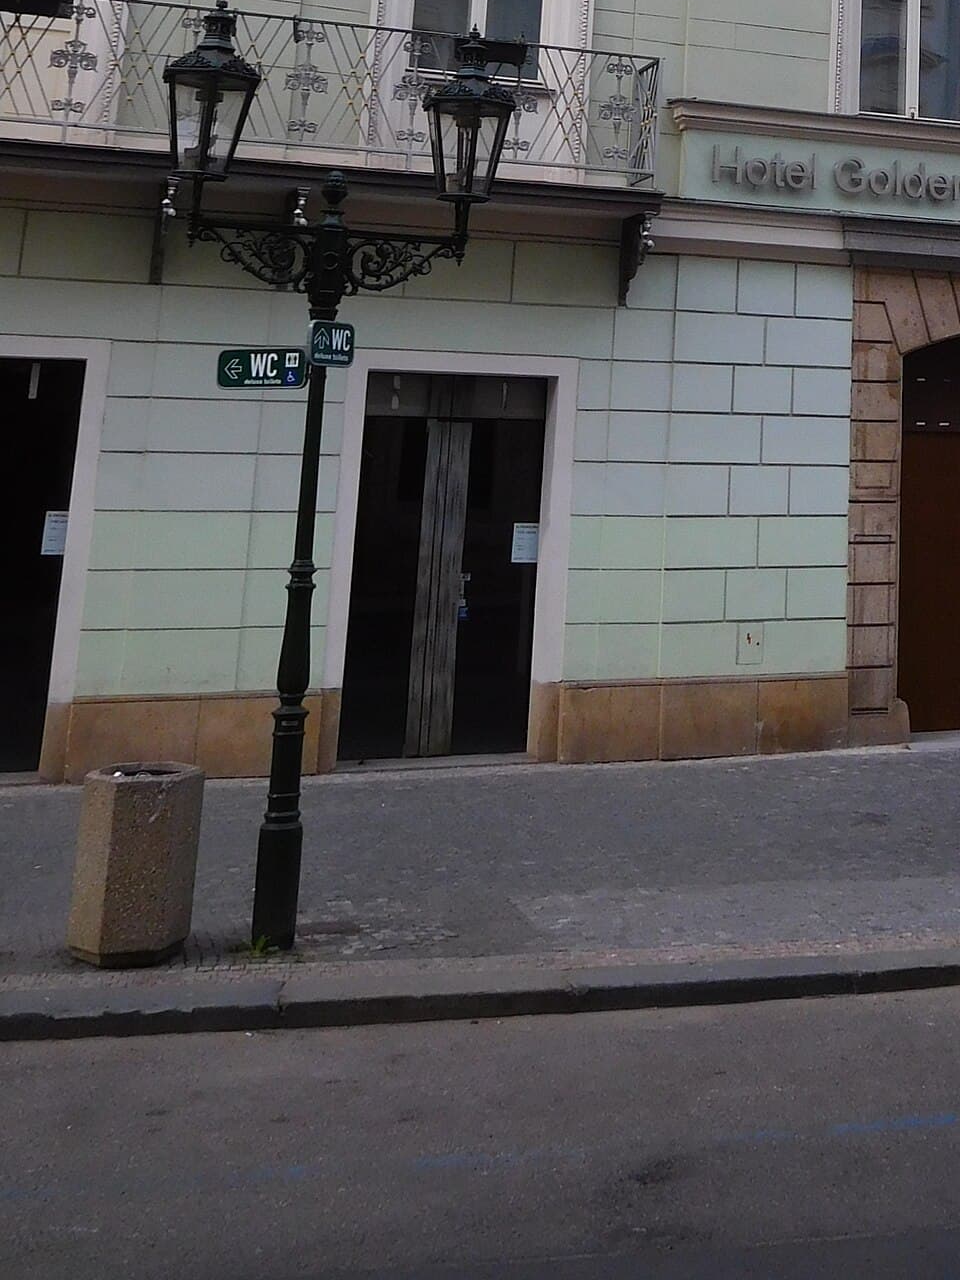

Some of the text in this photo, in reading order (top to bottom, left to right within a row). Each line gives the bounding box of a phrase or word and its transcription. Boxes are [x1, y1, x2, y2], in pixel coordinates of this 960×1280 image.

[711, 144, 818, 191] Hotel
[332, 328, 351, 351] WC
[250, 352, 278, 378] WC
